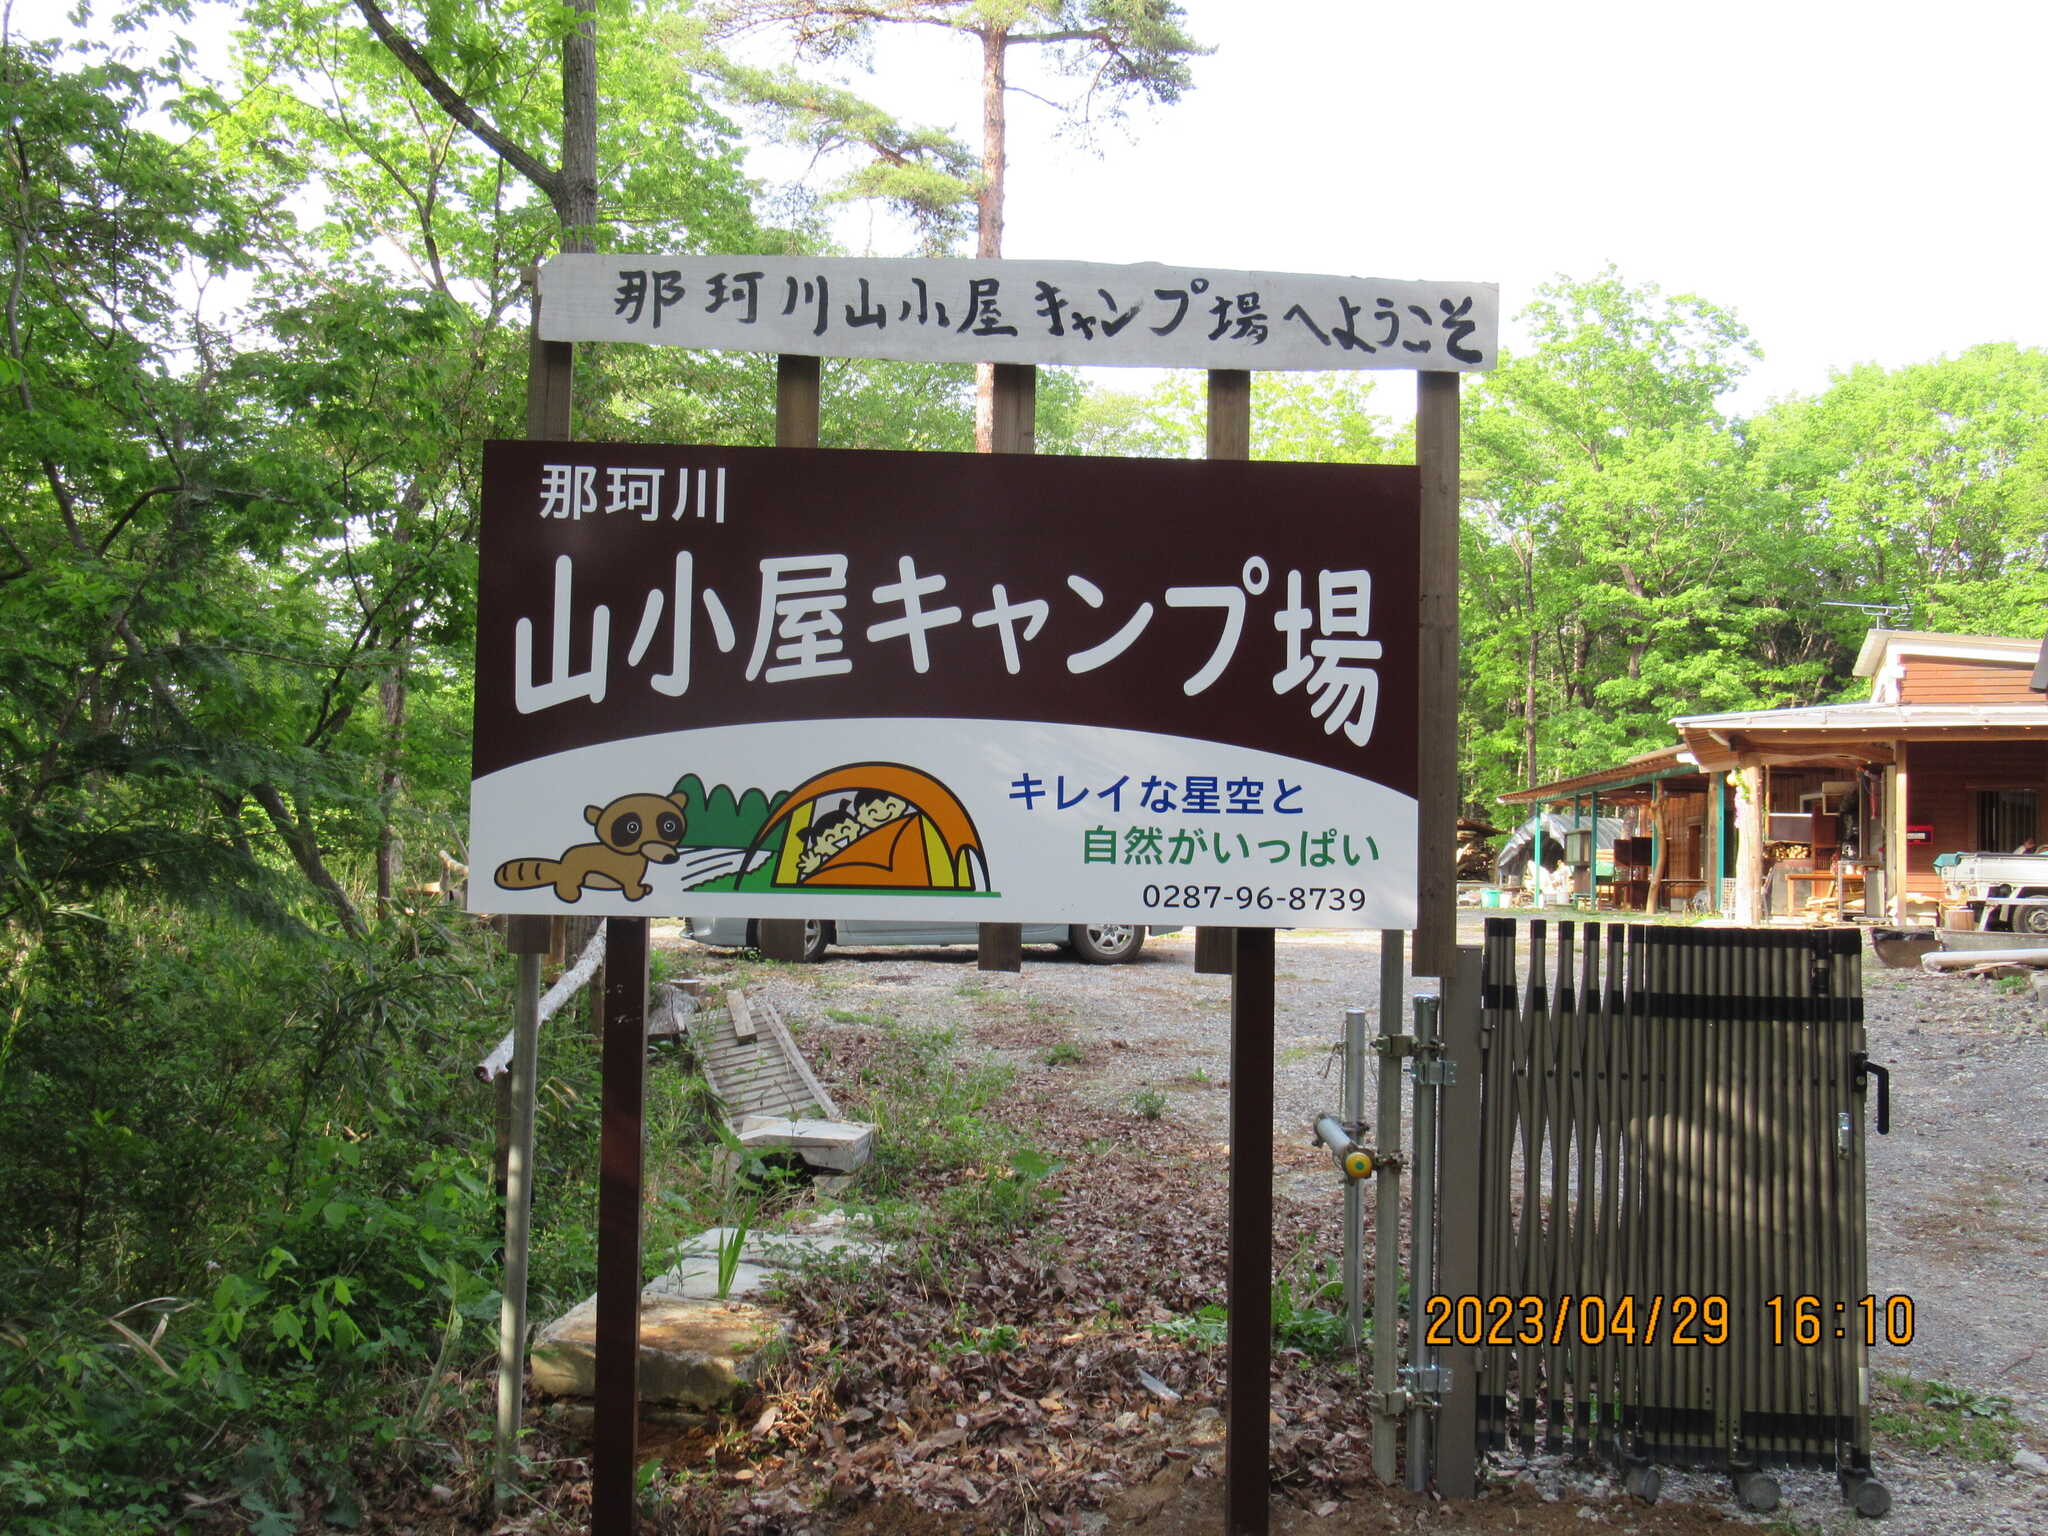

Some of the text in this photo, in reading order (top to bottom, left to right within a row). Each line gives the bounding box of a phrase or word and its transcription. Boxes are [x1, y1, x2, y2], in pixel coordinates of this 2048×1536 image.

[615, 269, 1483, 364] 那珂川山小屋キャンプ場へようこそ
[539, 464, 727, 524] 那珂川
[514, 550, 1384, 748] 山小屋キャンプ場
[1008, 772, 1304, 815] キレイな星空と
[1083, 825, 1379, 868] 自然がいっぱい
[1143, 885, 1365, 911] 0287-96-8739
